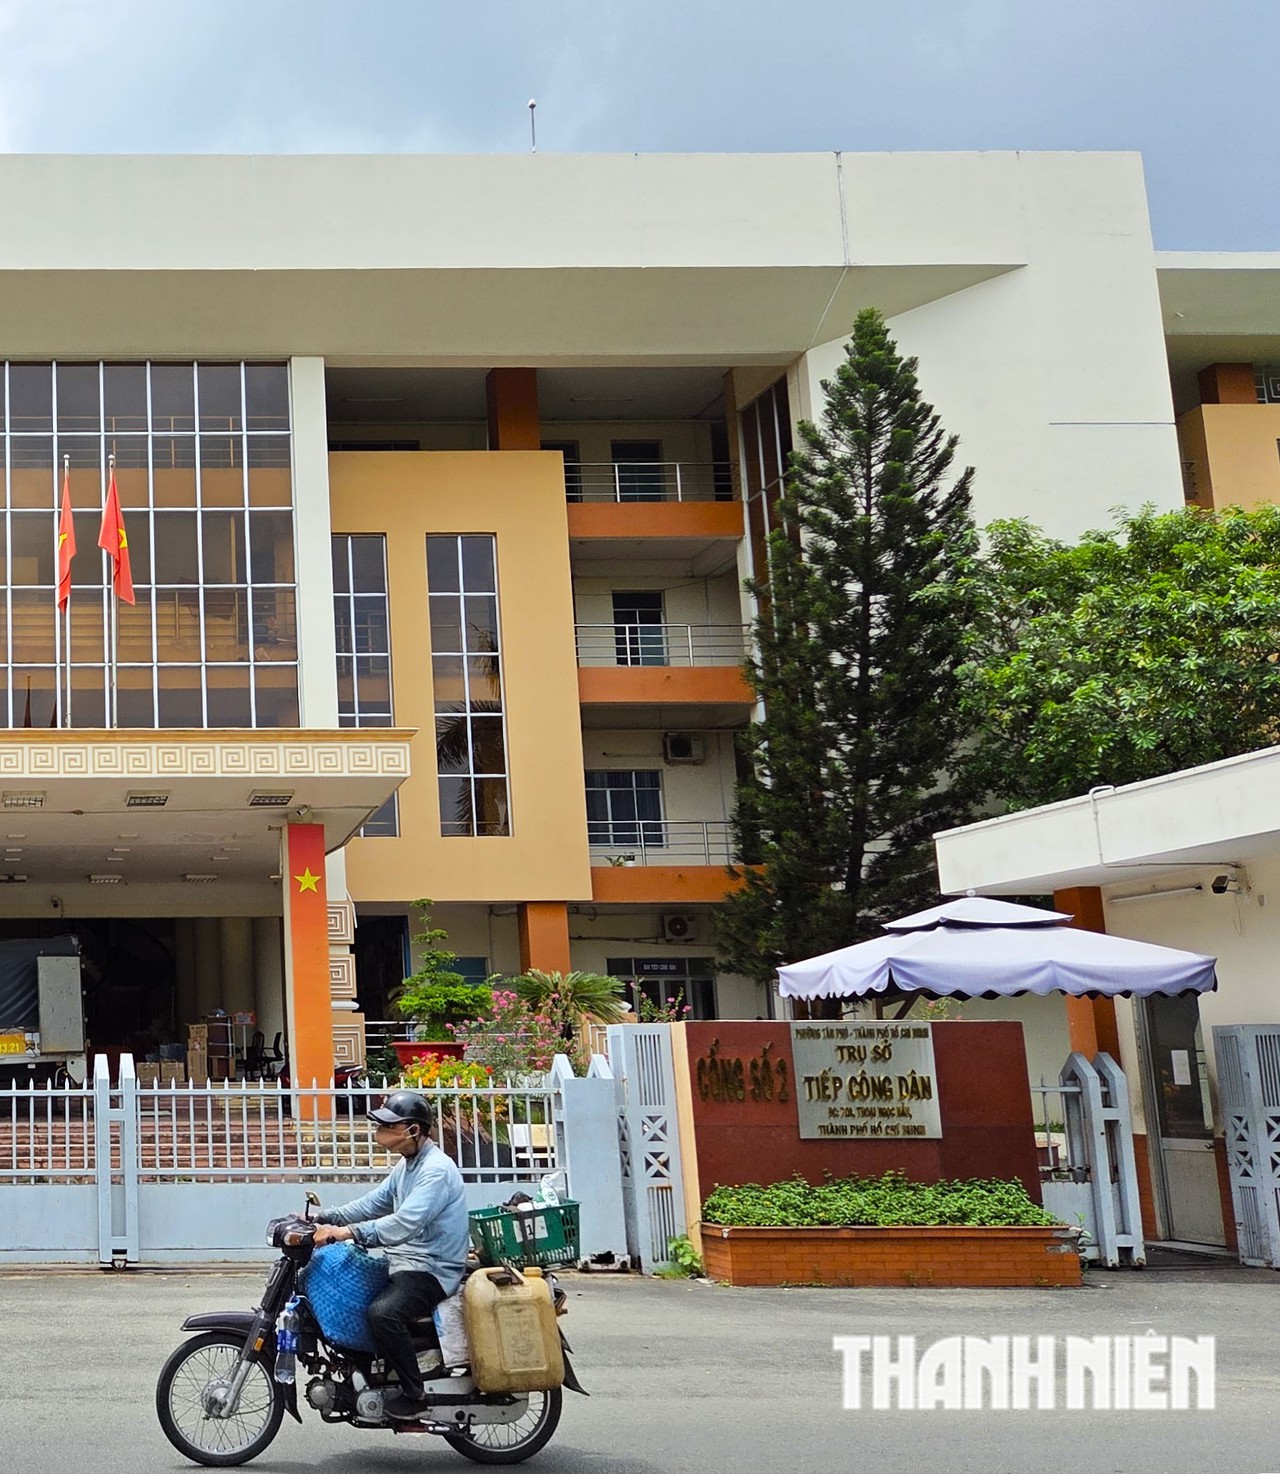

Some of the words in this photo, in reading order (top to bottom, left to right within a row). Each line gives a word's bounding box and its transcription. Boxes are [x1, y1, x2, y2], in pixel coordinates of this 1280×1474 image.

[836, 1044, 867, 1066] TRỤ
[871, 1039, 892, 1062] SỞ
[777, 1058, 789, 1103] 2
[803, 1067, 843, 1102] TIẾP
[848, 1069, 894, 1101] CÔNG
[896, 1069, 932, 1101] DÂN
[818, 1122, 848, 1136] THÀNH
